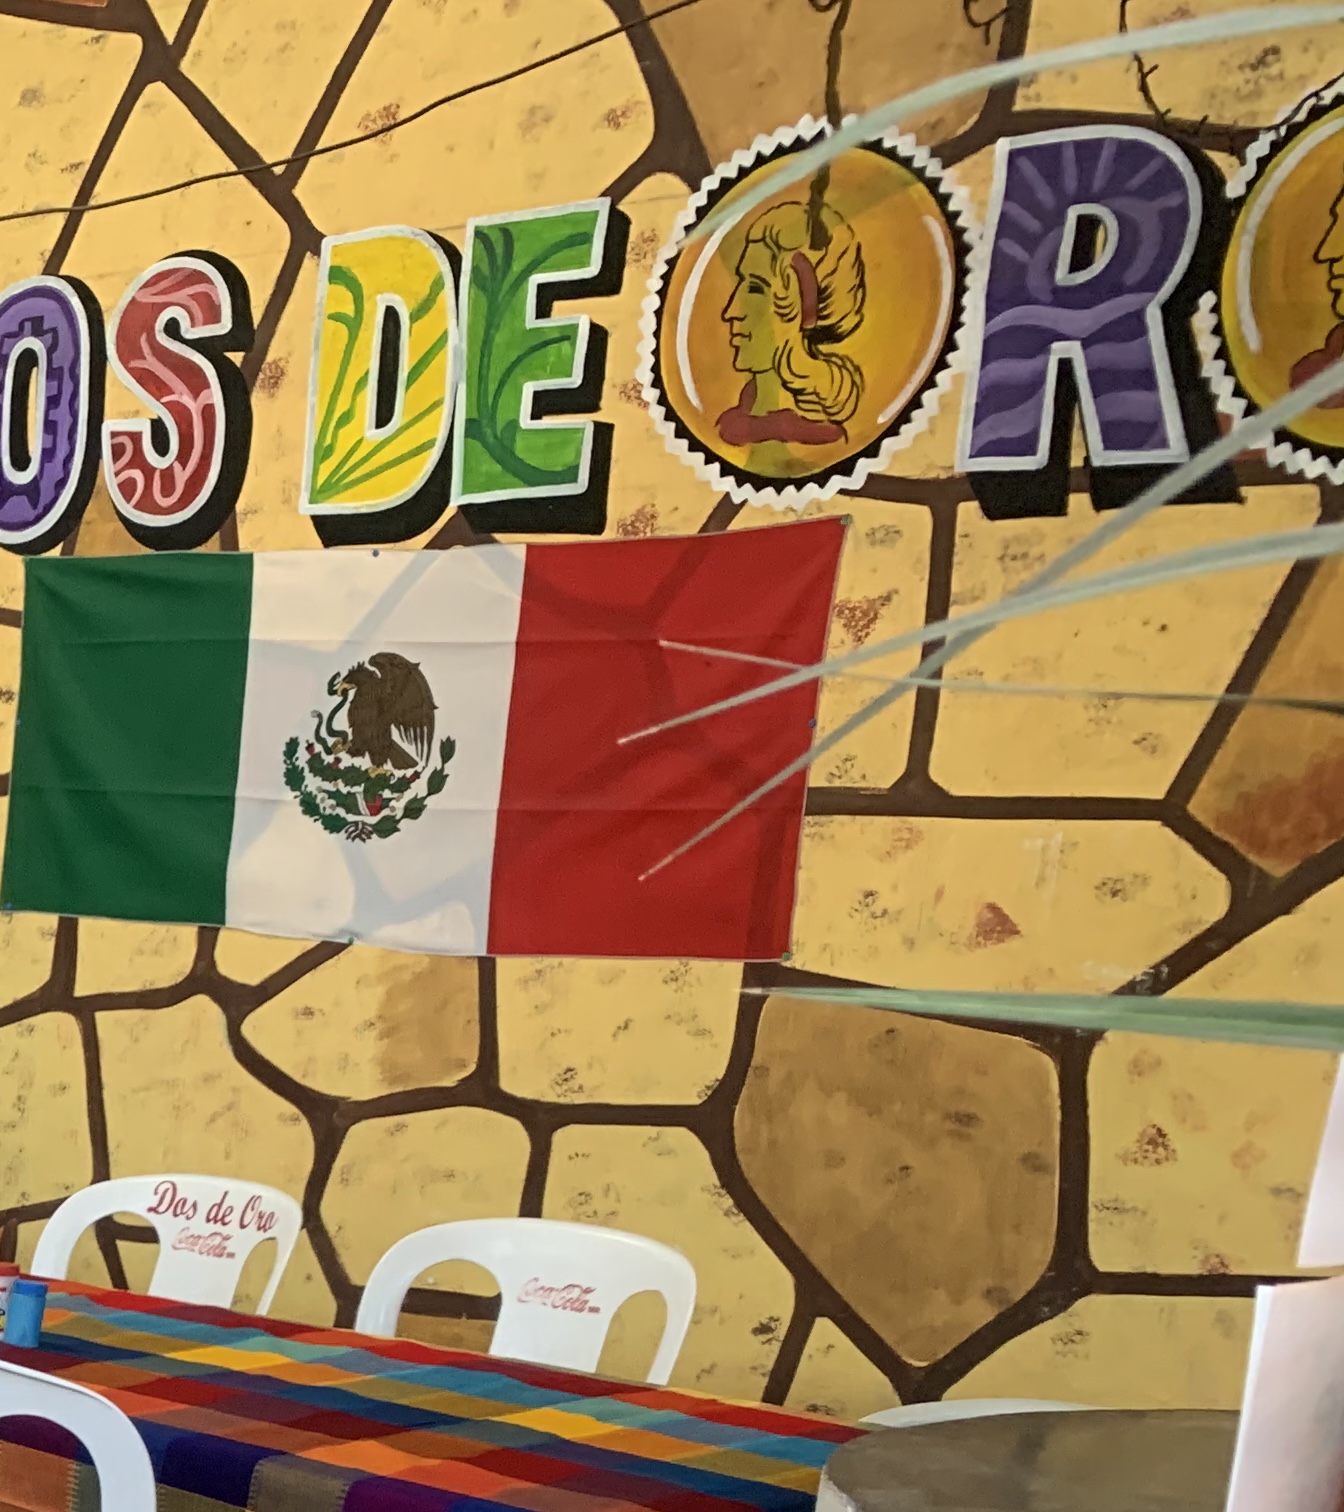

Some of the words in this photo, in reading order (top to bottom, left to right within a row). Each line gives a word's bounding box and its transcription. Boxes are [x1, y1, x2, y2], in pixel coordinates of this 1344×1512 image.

[302, 197, 620, 522] DE
[148, 1180, 198, 1219] Dos
[206, 1191, 232, 1226] de
[239, 1195, 279, 1232] Oro
